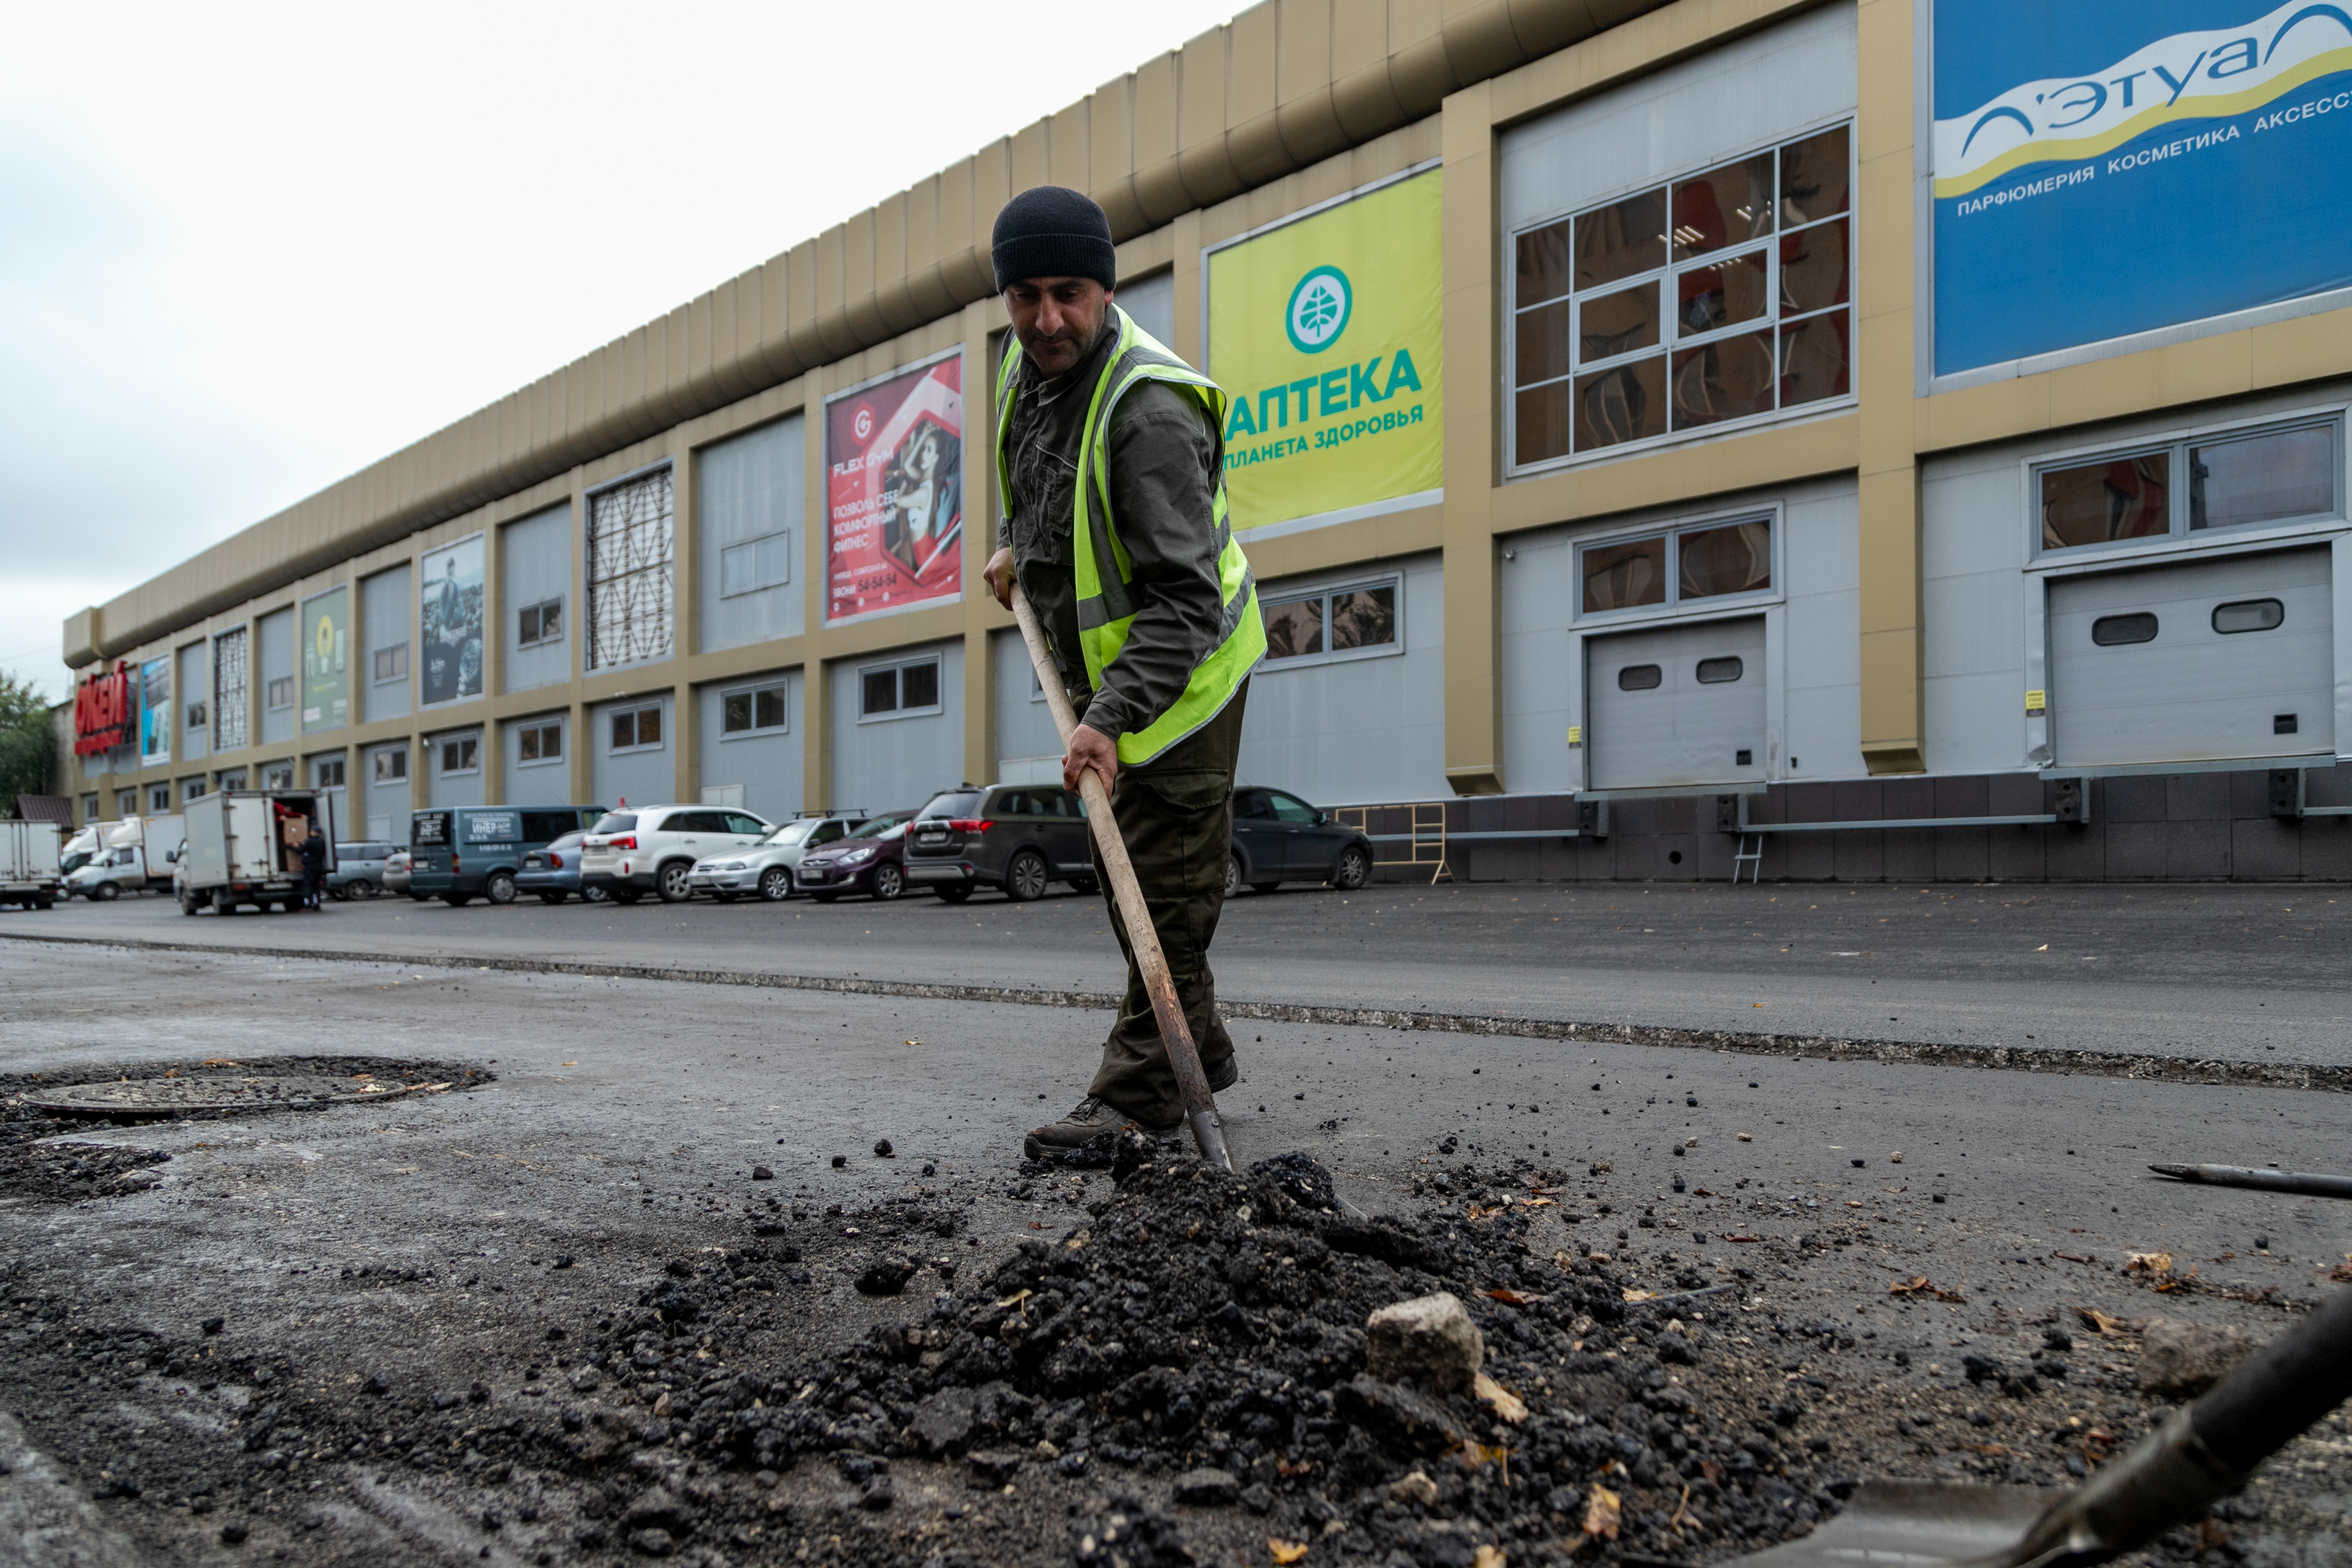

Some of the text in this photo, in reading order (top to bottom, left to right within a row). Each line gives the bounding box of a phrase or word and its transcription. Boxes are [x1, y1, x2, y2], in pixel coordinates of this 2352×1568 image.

[1958, 89, 2352, 217] ПАРФЮМЕРИЯ КОСМЕТИКА АКСЕСС
[1225, 349, 1422, 441] АПТЕКА
[1224, 404, 1423, 470] ПЛАНЕТА ЗДОРОВЬЯ
[833, 446, 894, 478] FLEX GYM
[833, 489, 898, 519] ПОЗВОЛЬ СЕБЕ
[833, 505, 896, 537] КОМФОРТНЫЙ
[833, 533, 869, 553] ФИТНЕС
[833, 572, 897, 599] ЗВОНИ 54-54-54
